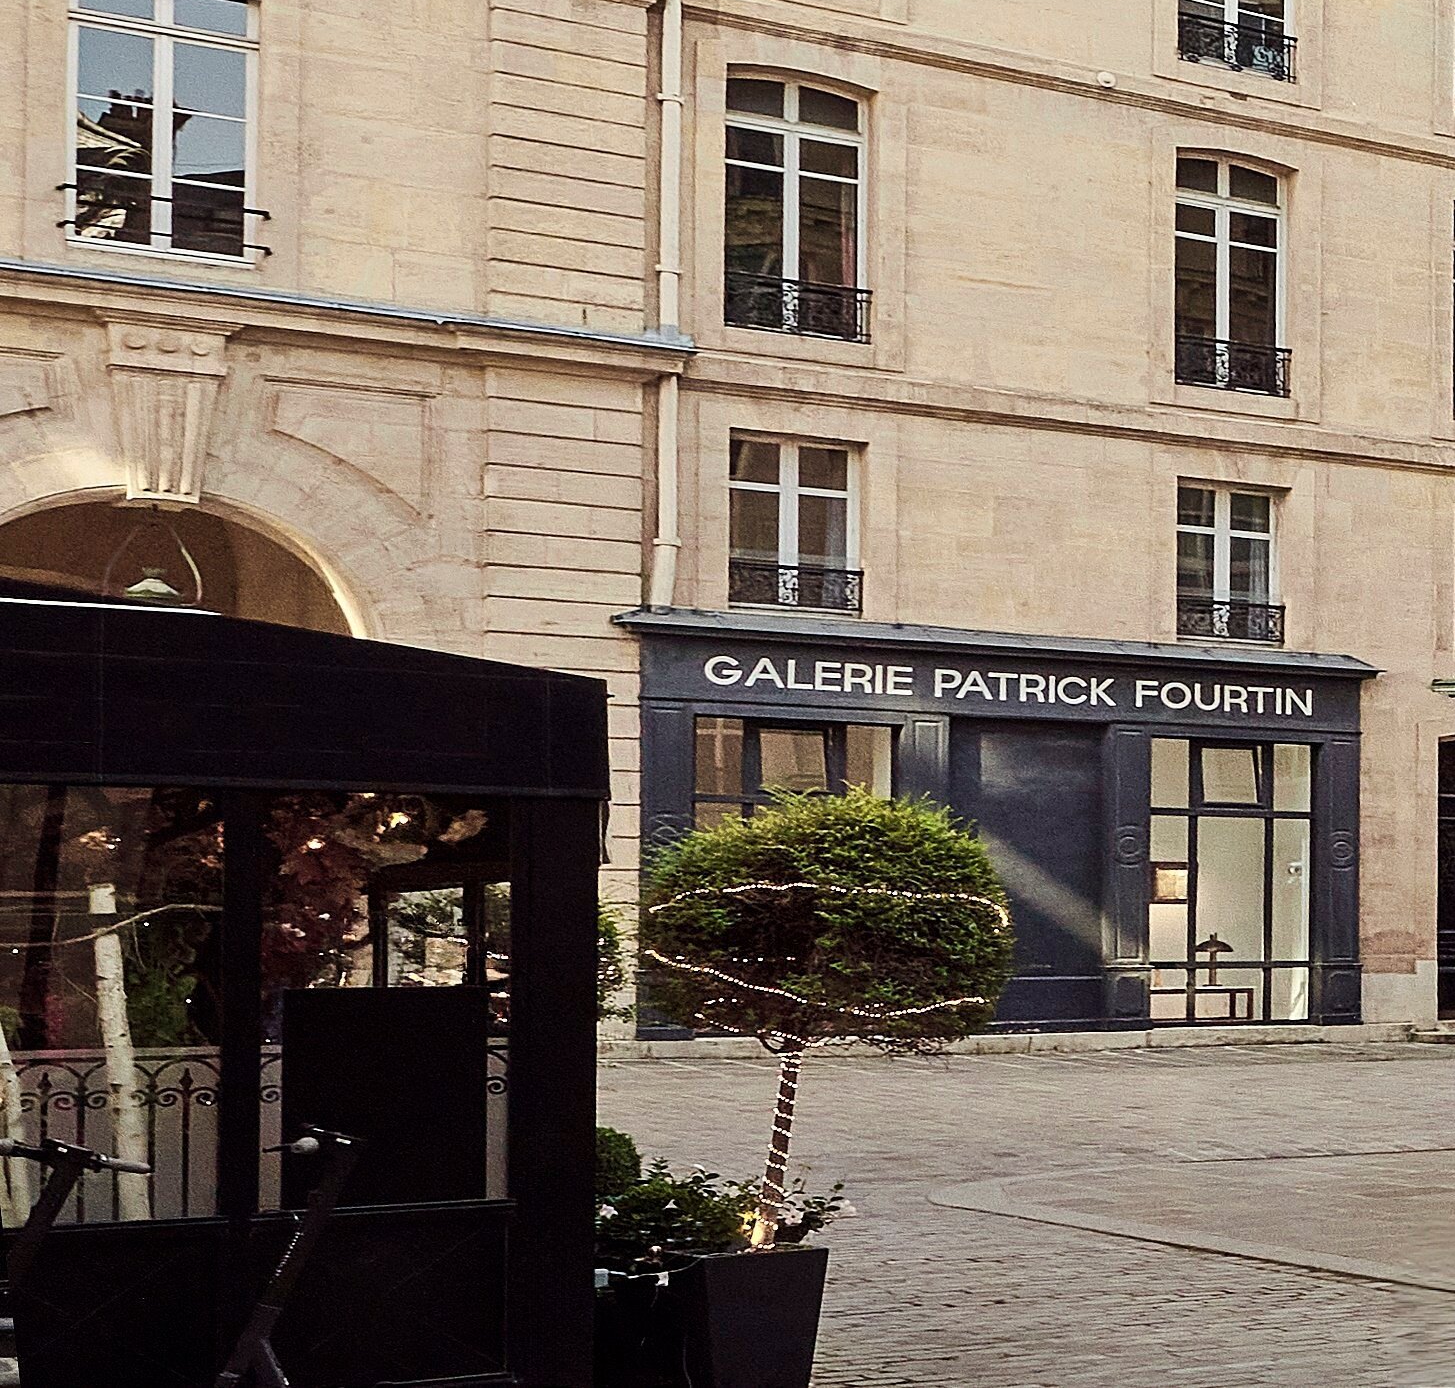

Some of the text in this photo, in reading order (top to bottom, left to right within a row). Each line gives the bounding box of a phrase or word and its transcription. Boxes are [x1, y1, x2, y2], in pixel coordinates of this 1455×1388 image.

[704, 656, 1315, 716] GALERIE PATRICK FOURTIN
